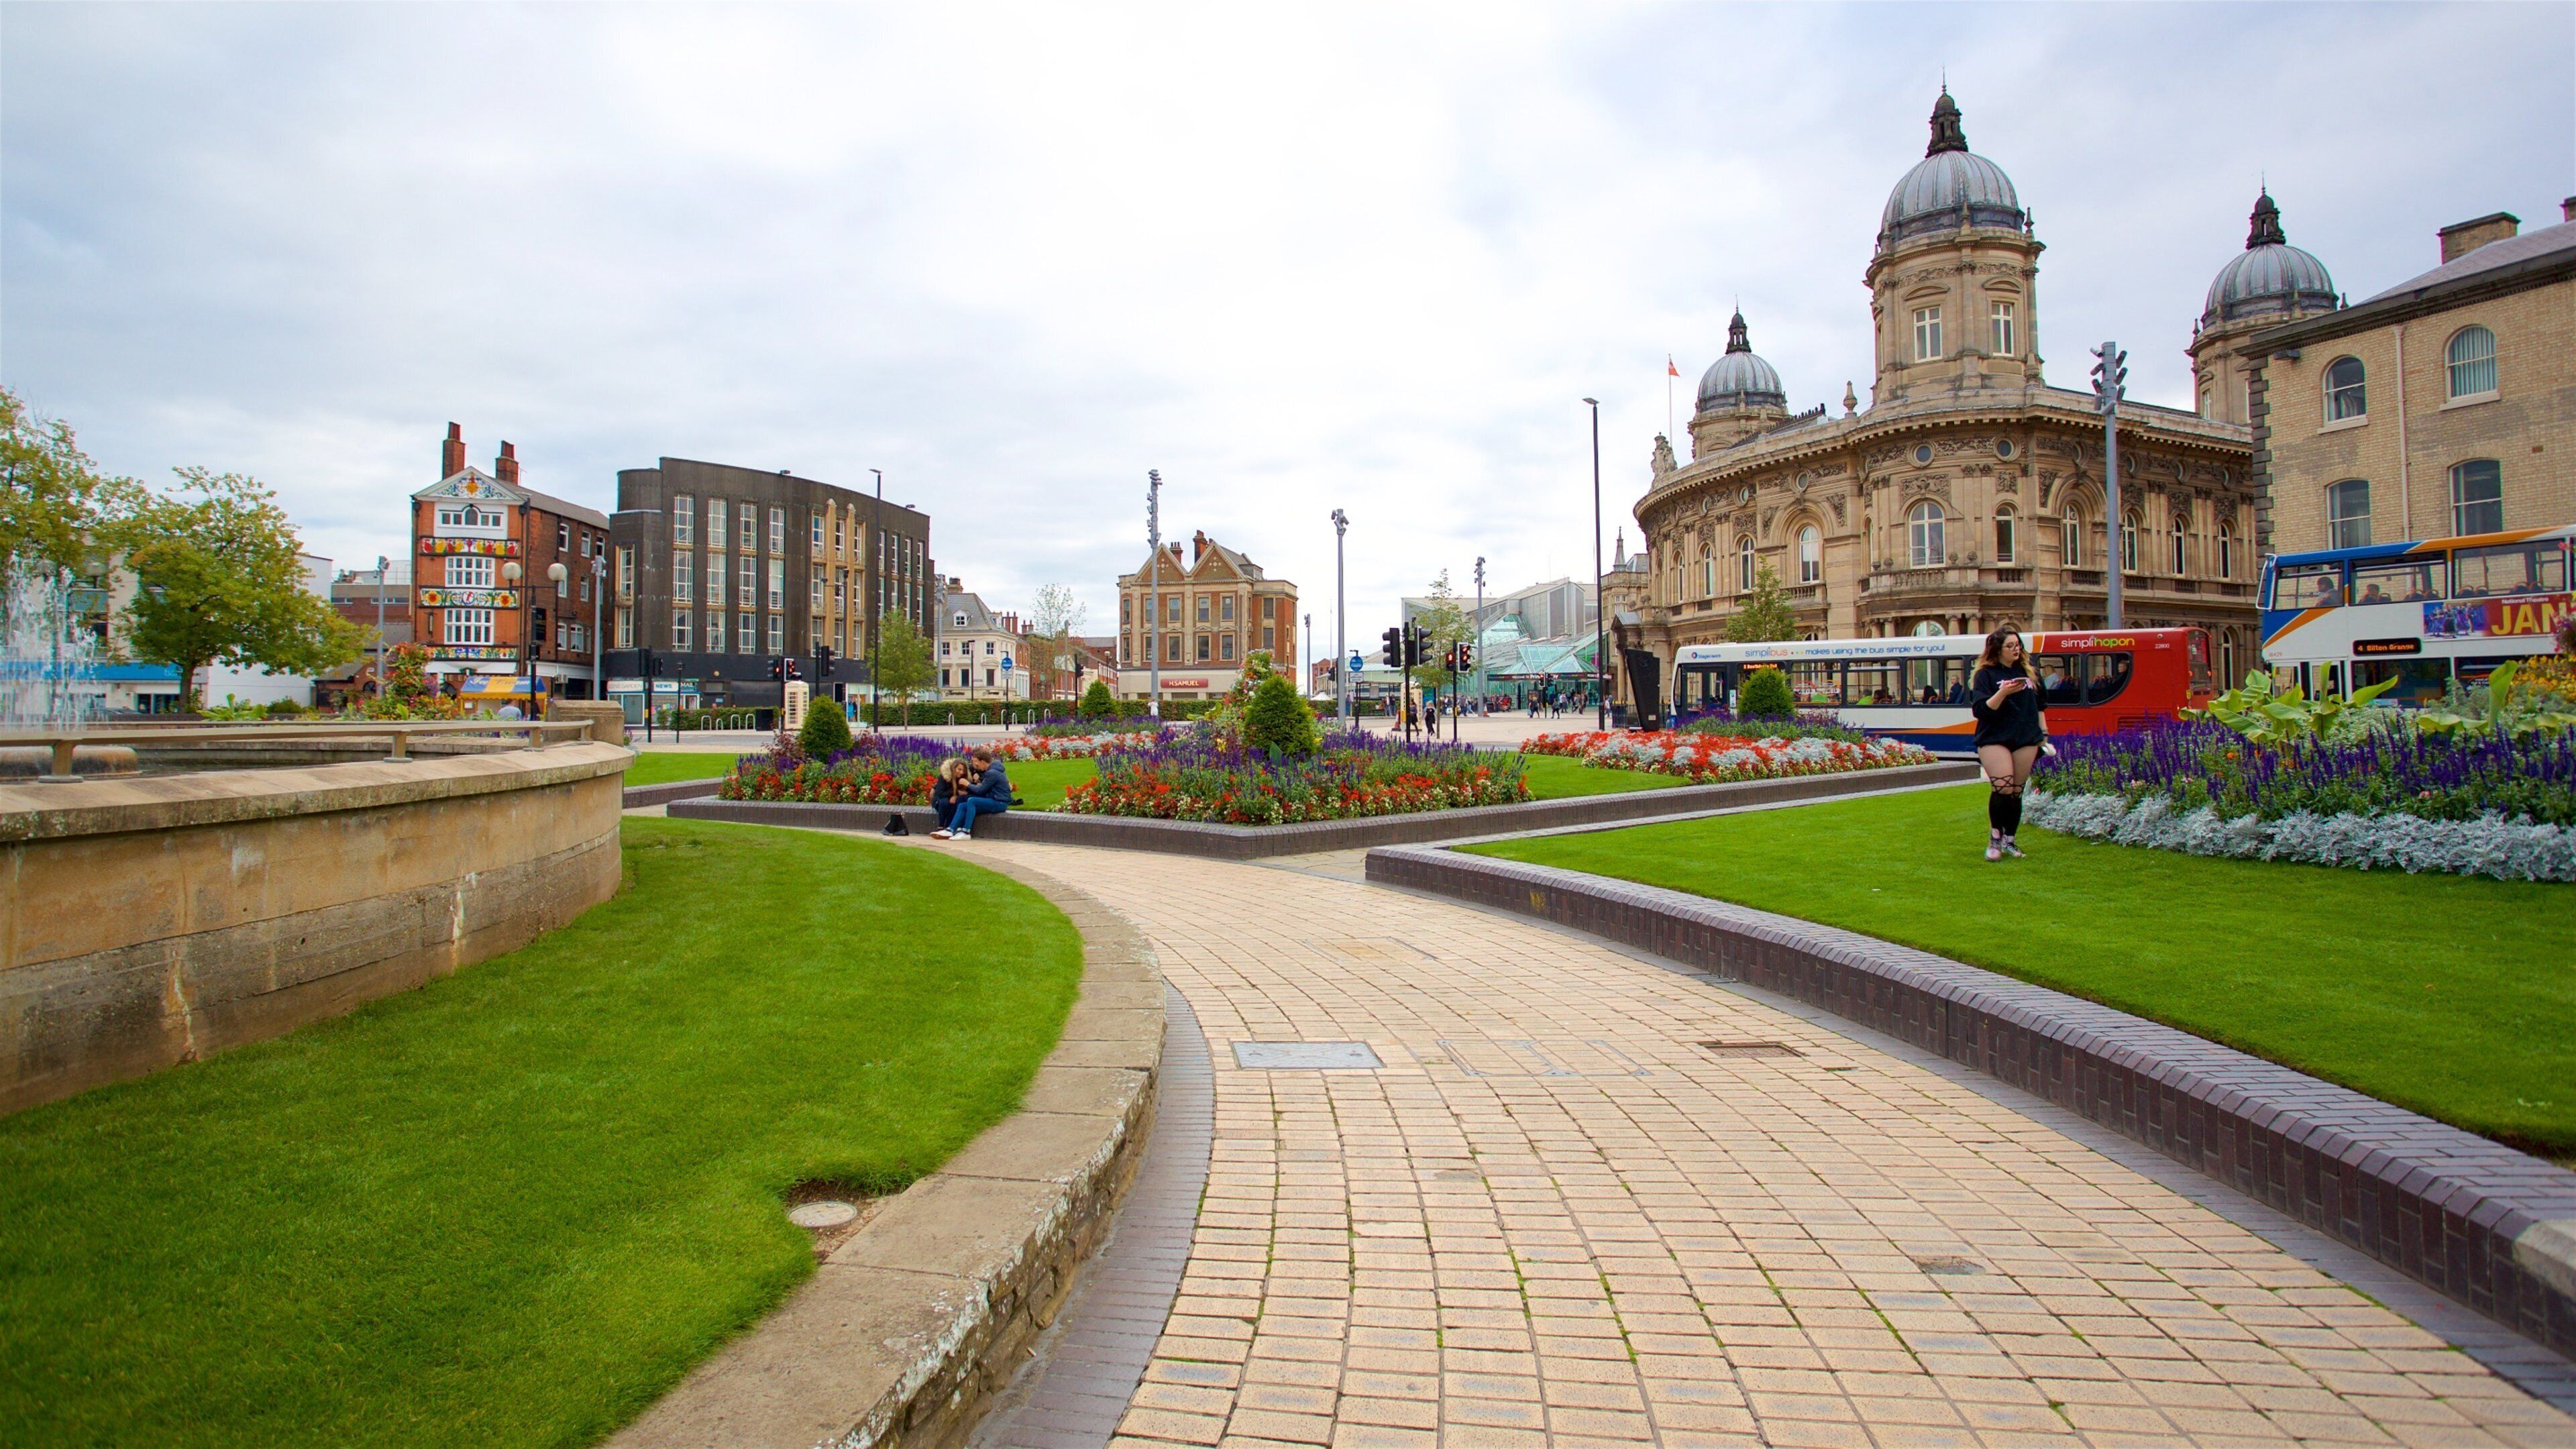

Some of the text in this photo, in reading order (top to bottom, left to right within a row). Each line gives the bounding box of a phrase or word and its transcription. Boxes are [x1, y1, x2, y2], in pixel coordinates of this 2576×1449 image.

[2491, 602, 2576, 635] JAN
[1745, 646, 1788, 658] simplibus
[1832, 647, 1852, 655] using
[1855, 647, 1868, 655] the
[1870, 646, 1884, 654] bus
[1886, 645, 1911, 654] simple
[1927, 644, 1945, 652] you!
[470, 677, 488, 685] Ice
